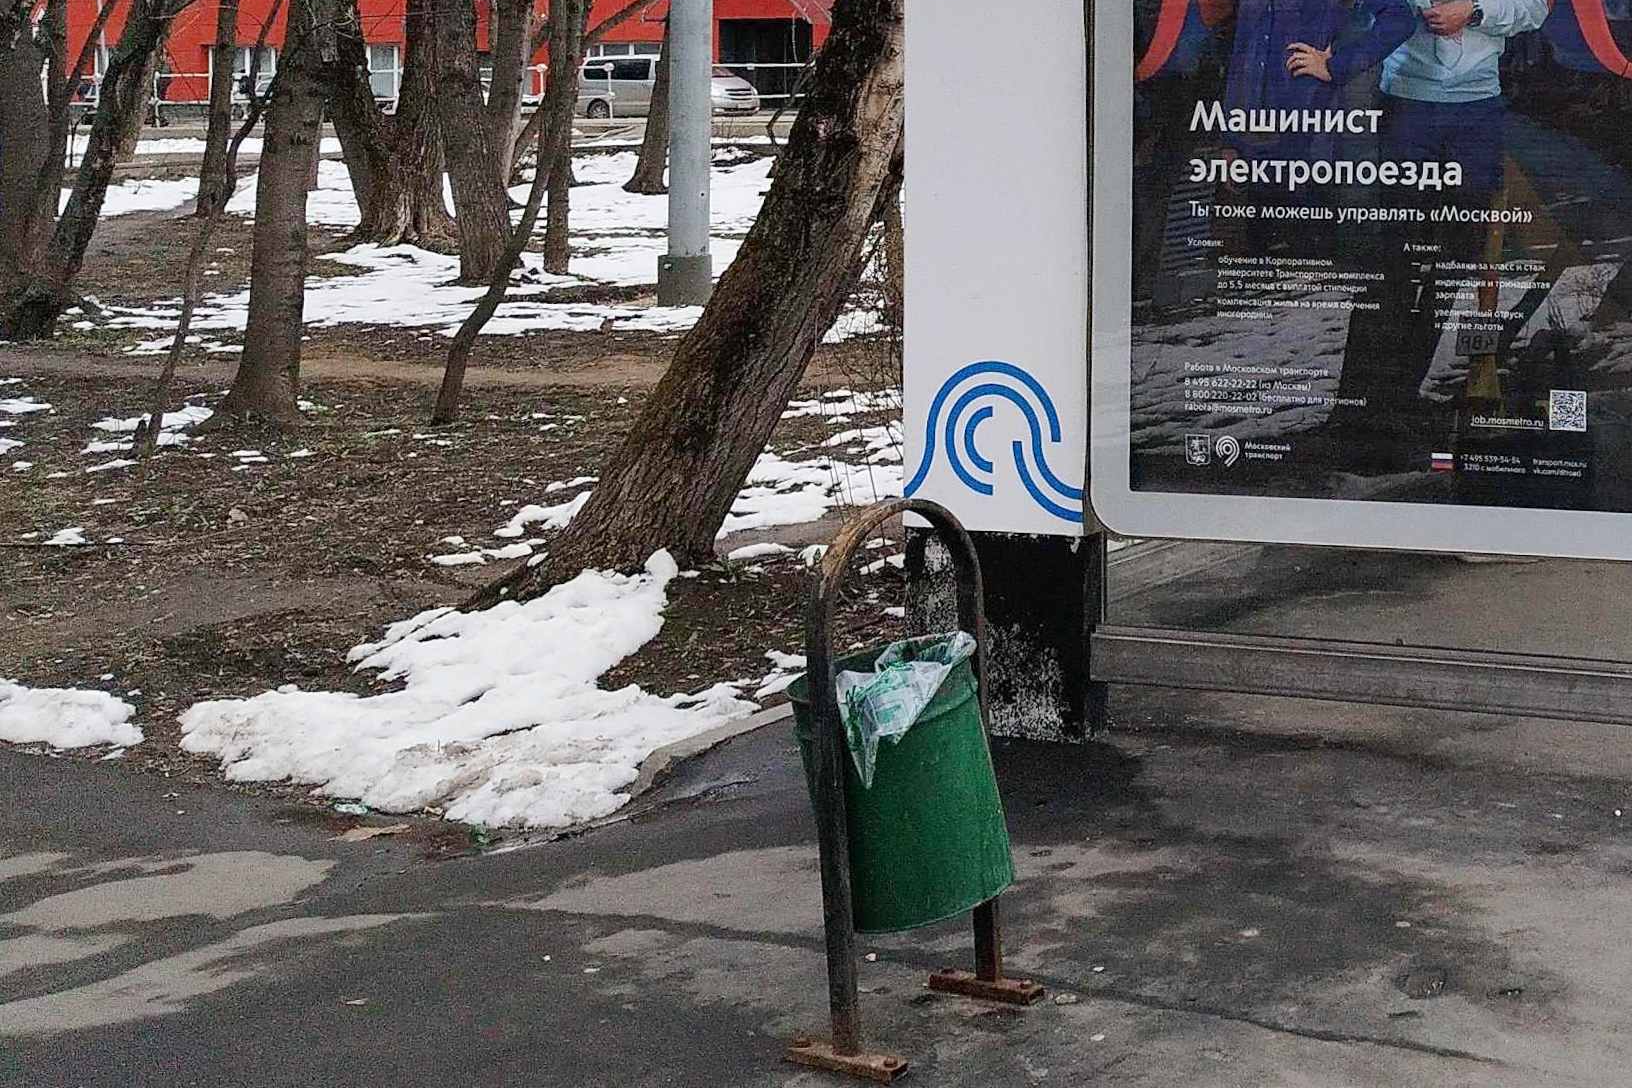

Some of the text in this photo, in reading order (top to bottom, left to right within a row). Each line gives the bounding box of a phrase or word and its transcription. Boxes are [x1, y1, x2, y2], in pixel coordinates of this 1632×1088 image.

[1189, 100, 1383, 134] Машинист
[1188, 157, 1463, 192] электропоезда
[1188, 200, 1534, 224] Ты тоже можешь управлять «Москвой»
[1402, 242, 1411, 253] А
[1217, 255, 1258, 267] обучение
[1265, 256, 1334, 267] Корпоративном
